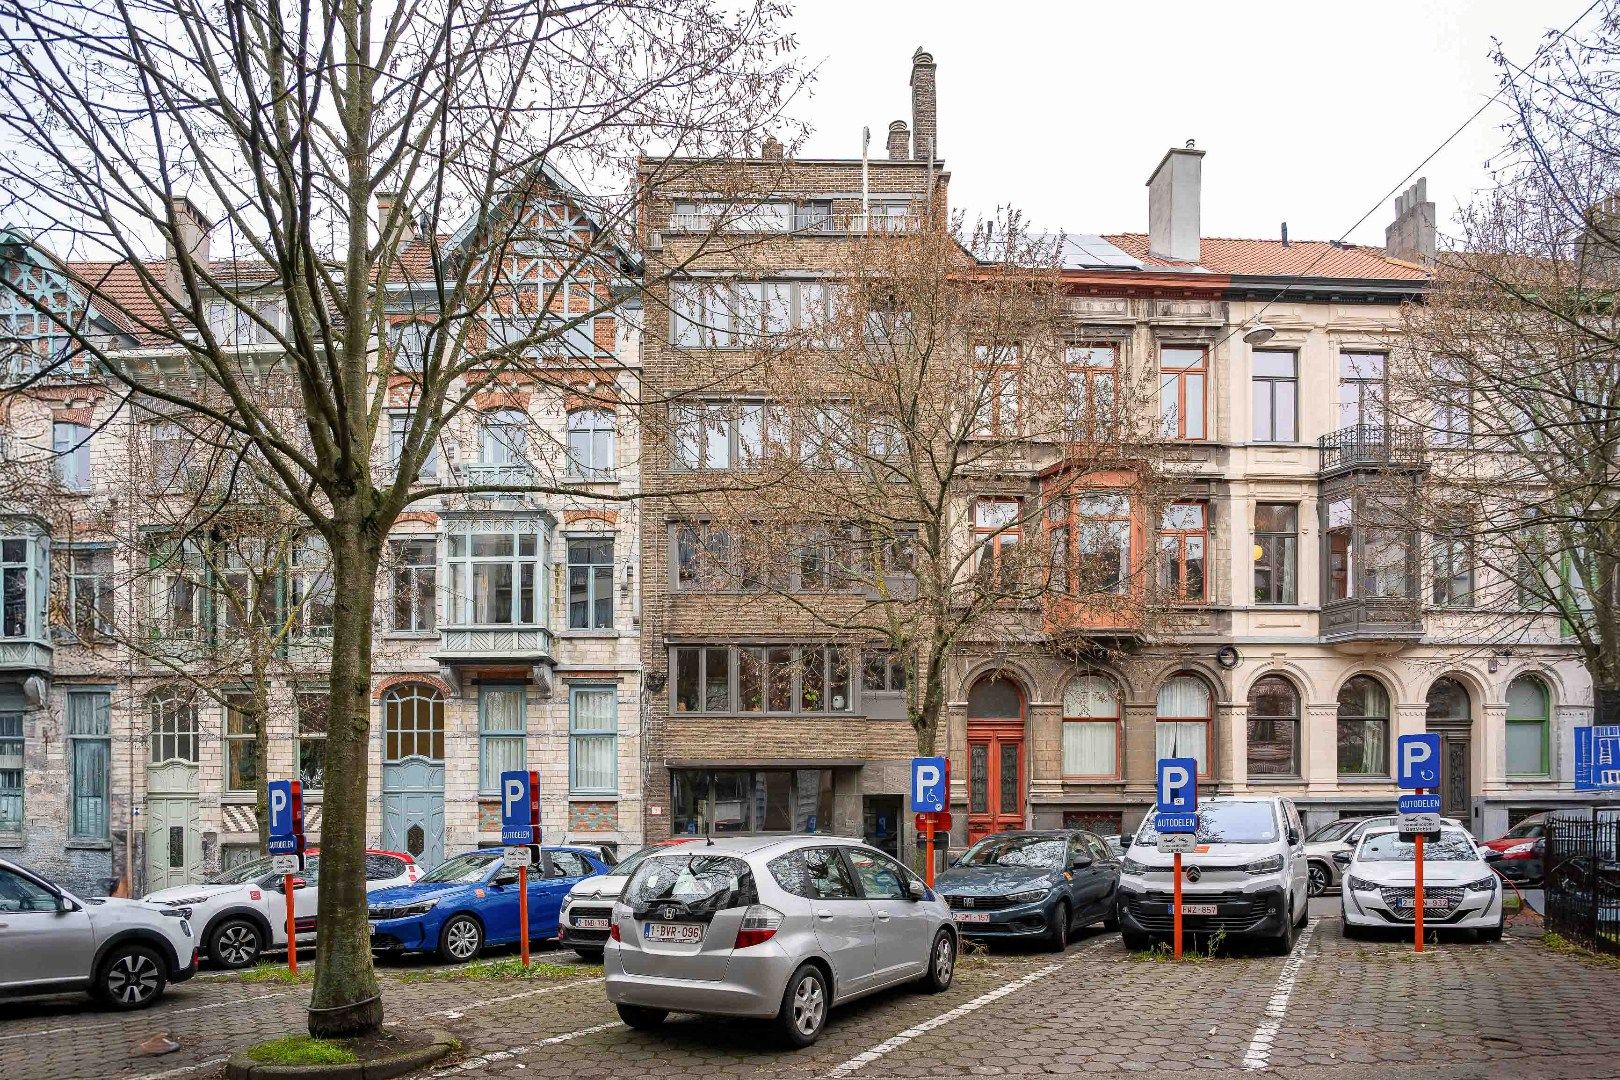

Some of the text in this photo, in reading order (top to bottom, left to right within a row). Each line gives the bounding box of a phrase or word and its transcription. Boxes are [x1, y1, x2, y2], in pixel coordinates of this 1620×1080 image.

[1403, 741, 1432, 778] P
[916, 765, 940, 803] P
[1162, 766, 1189, 805] P
[271, 789, 287, 827] P
[505, 779, 524, 817] P
[1400, 799, 1440, 808] AUTODELEN
[1157, 818, 1195, 827] AUTODELEN
[1182, 905, 1216, 914] FWZ-857
[1402, 899, 1448, 907] 2-N-932
[651, 925, 699, 938] 1-BVR-096
